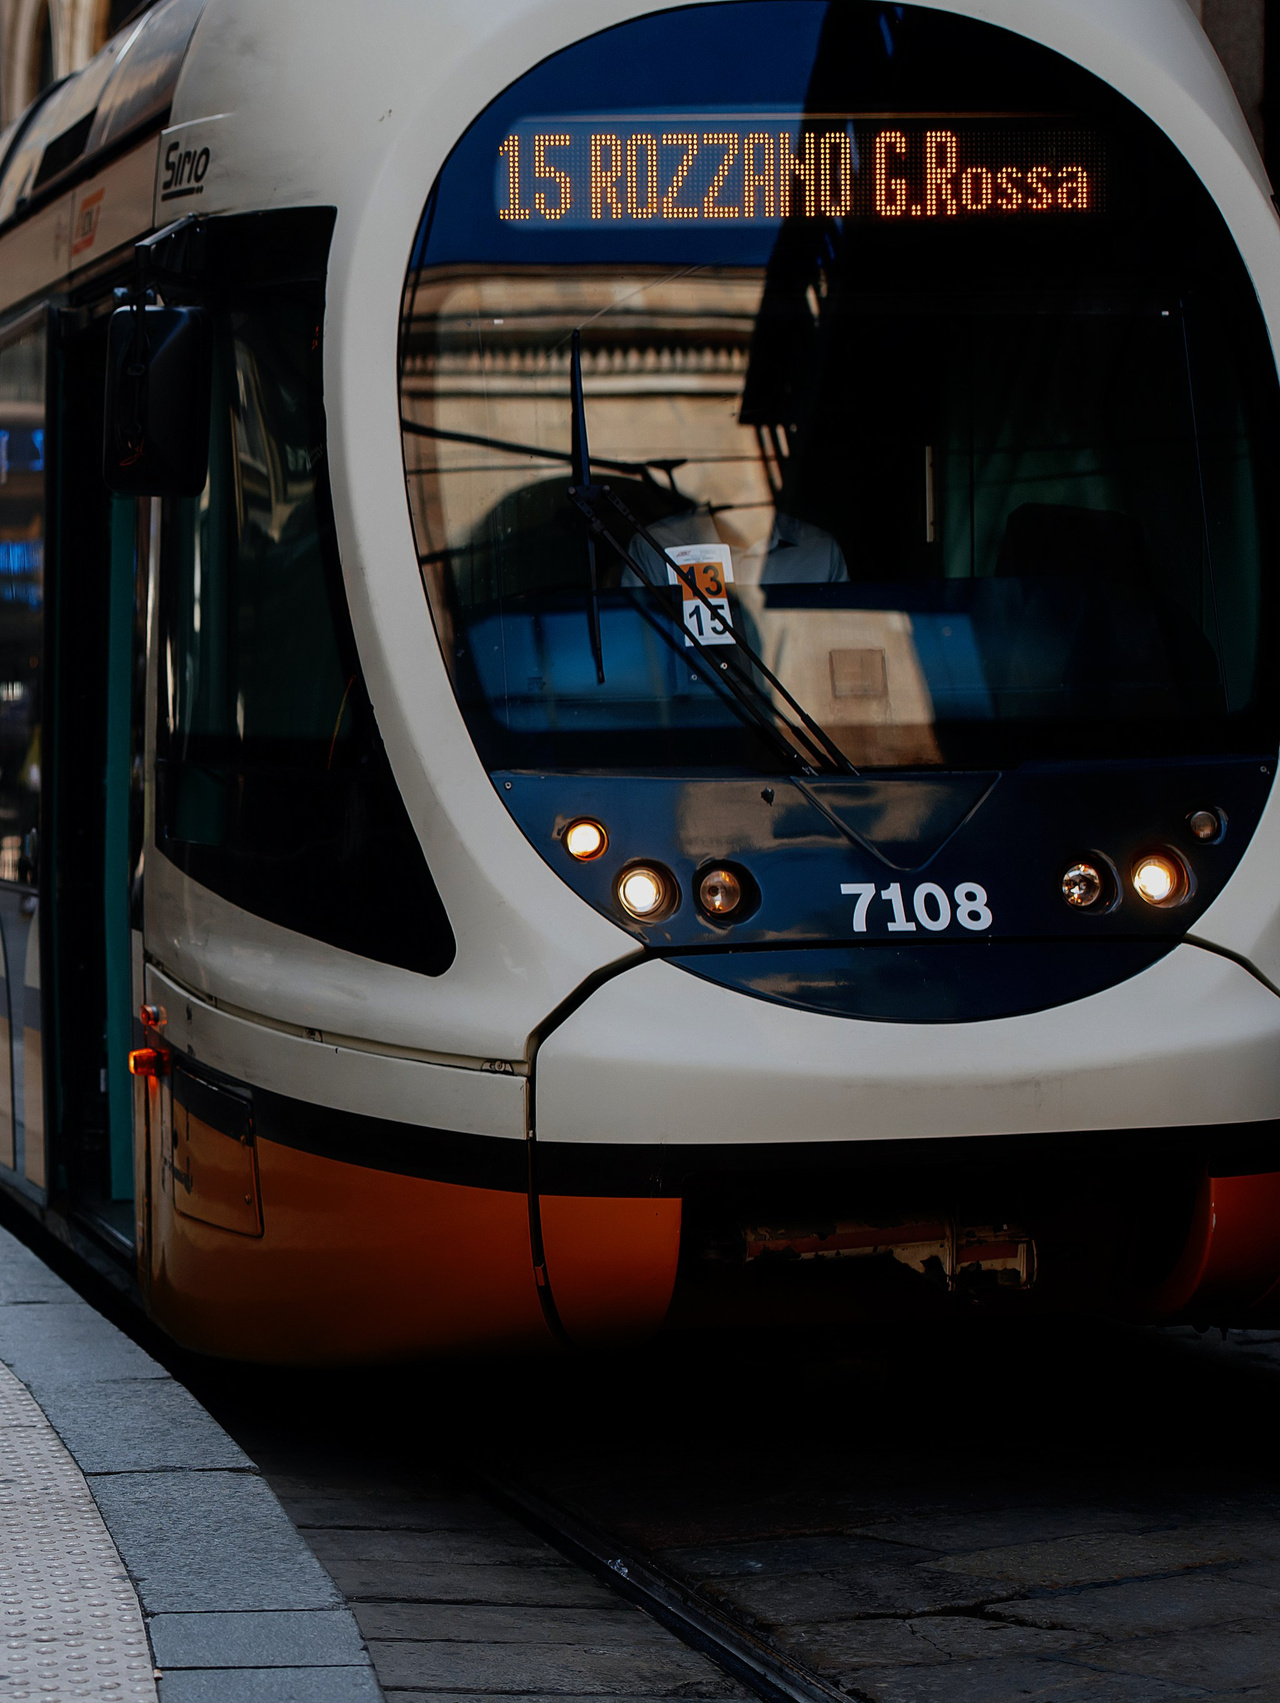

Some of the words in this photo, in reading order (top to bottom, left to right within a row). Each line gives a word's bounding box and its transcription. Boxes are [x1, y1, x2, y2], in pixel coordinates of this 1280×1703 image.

[499, 134, 570, 219] 15
[591, 132, 851, 219] ROZZANO
[875, 131, 1088, 216] G.Rossa
[684, 565, 723, 597] 13
[688, 603, 728, 637] 15
[840, 881, 993, 932] 7108
